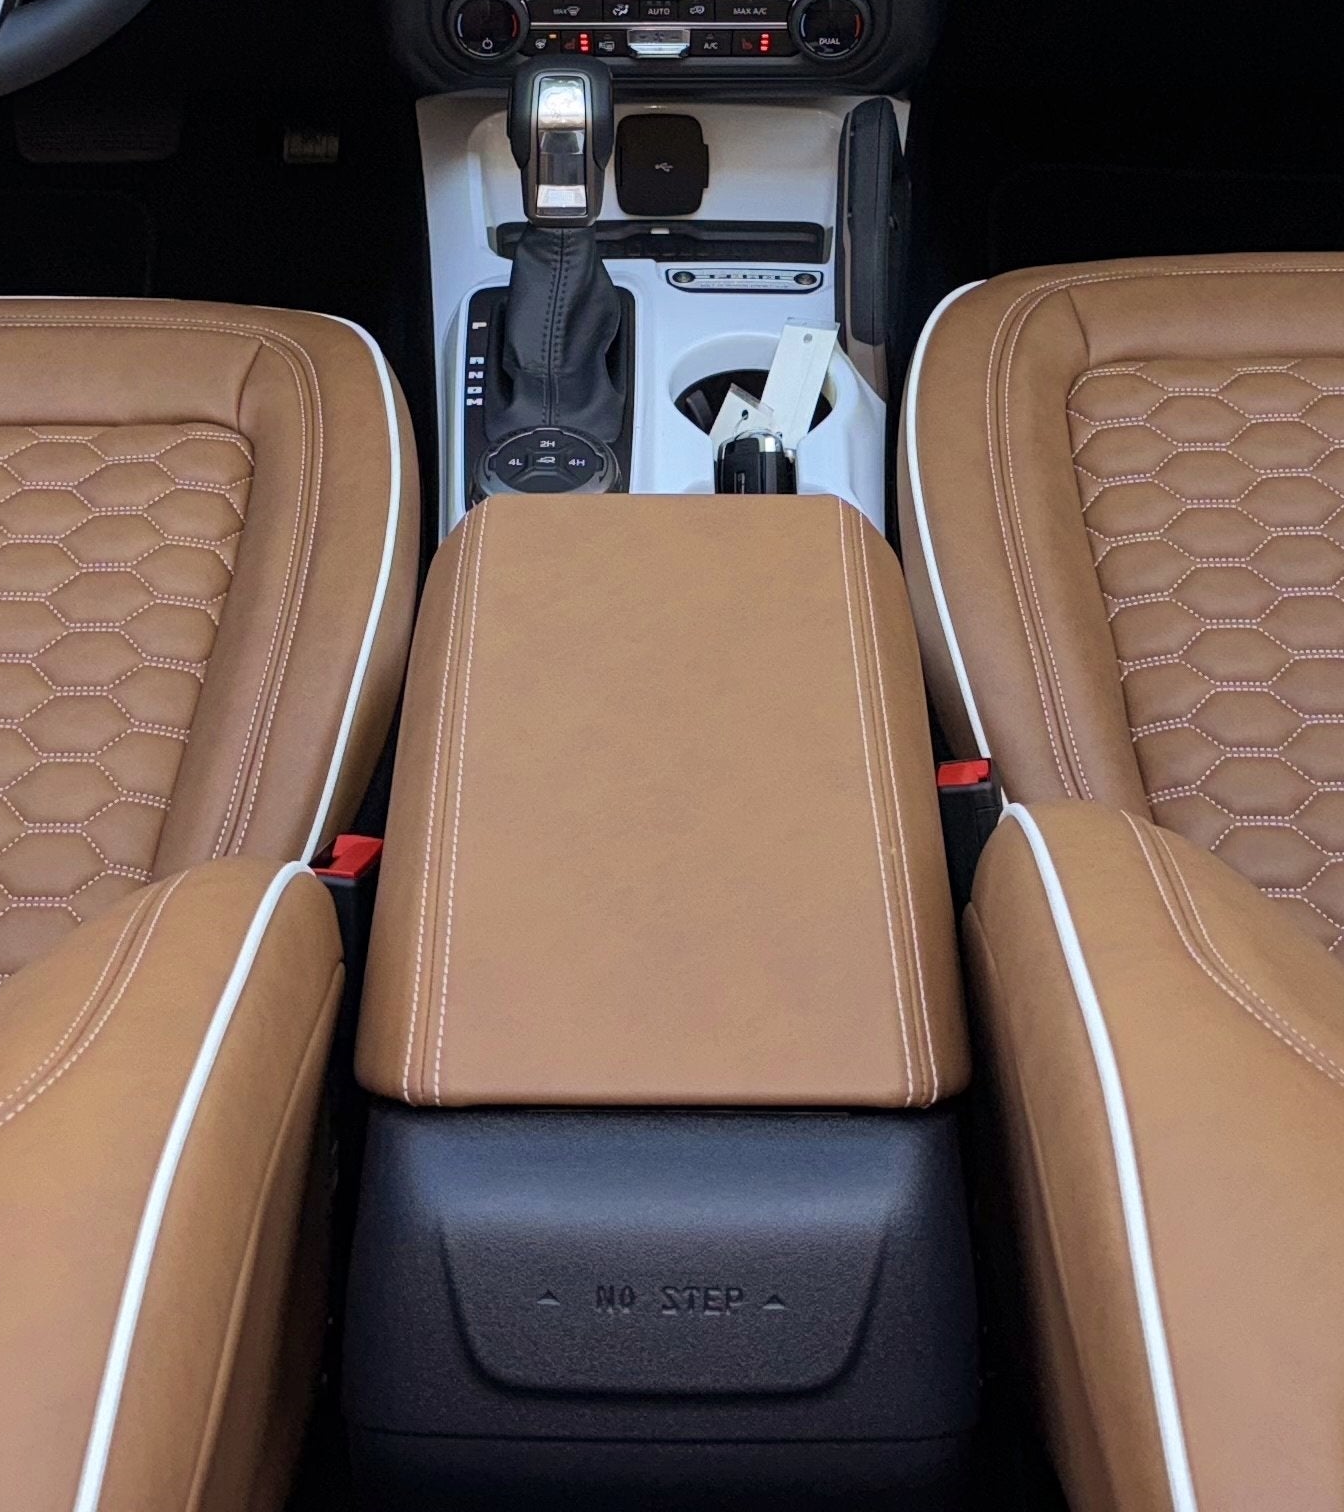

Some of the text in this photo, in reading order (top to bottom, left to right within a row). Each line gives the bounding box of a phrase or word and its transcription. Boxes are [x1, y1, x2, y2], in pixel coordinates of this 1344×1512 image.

[647, 7, 670, 16] AUTO
[733, 7, 767, 16] MAX A/C
[818, 37, 841, 45] DUAL
[703, 42, 718, 50] A/C
[539, 440, 556, 448] 2H
[507, 458, 586, 467] 4L 4H
[596, 1285, 744, 1316] NO STEP
